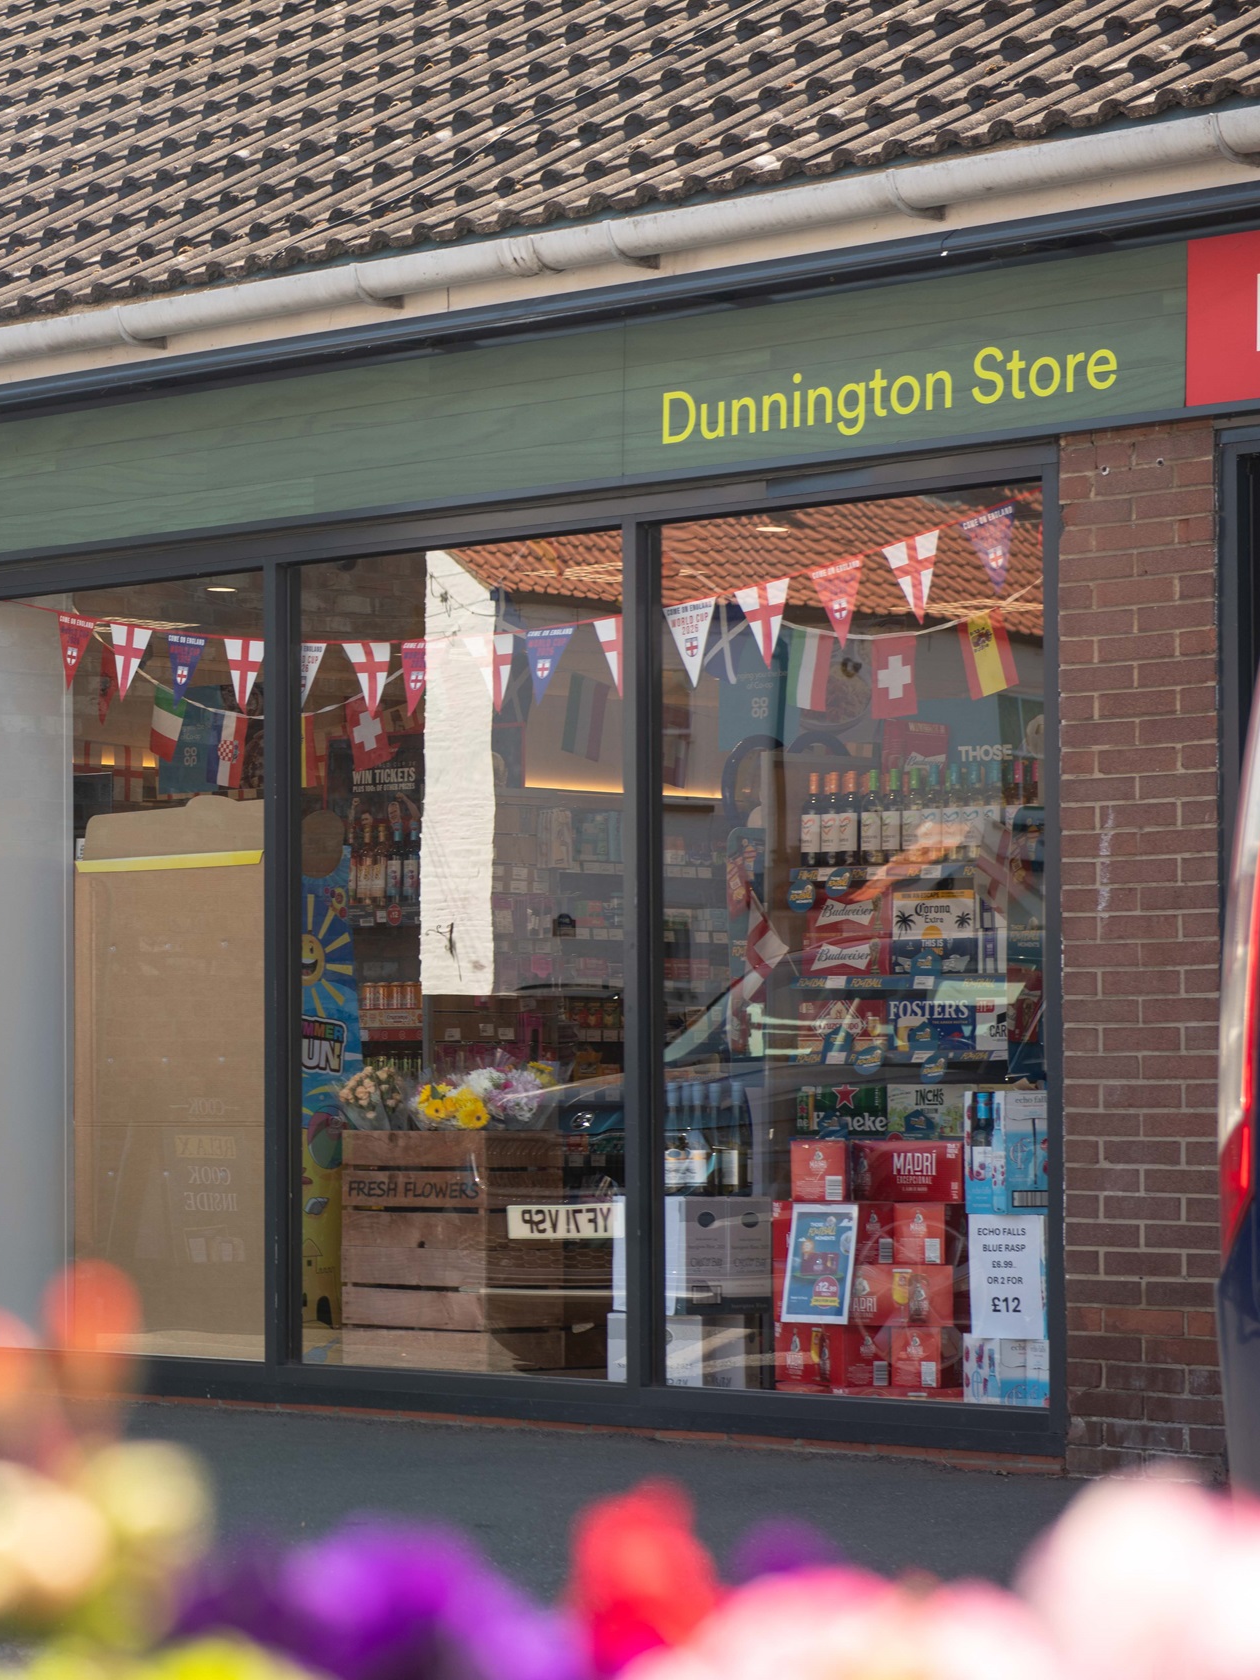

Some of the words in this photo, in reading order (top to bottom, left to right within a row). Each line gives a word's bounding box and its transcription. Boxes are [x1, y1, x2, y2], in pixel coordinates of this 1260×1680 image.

[661, 369, 952, 444] Dunnington
[972, 347, 1118, 405] Store
[667, 608, 680, 616] COME
[690, 601, 712, 612] ENGLAND
[76, 619, 94, 629] ENGLAND
[671, 616, 694, 628] WORLD
[696, 612, 709, 623] CUP
[550, 628, 573, 636] ENGLAND
[682, 624, 699, 635] 2026
[168, 635, 180, 643] COME
[186, 636, 205, 646] ENGLAND
[308, 656, 318, 664] CUP
[958, 744, 1013, 762] THOSE
[353, 770, 372, 785] WIN
[375, 767, 416, 784] TICKETS
[353, 785, 364, 793] PLUS
[376, 784, 383, 792] OF
[821, 904, 874, 918] Budweiser
[915, 903, 950, 917] Corona
[924, 915, 944, 924] Extra
[921, 939, 936, 947] THIS
[937, 939, 944, 947] IS
[817, 948, 871, 962] Budweiser
[890, 1000, 969, 1019] FOSTER'S
[302, 1021, 343, 1041] MMER
[302, 1038, 341, 1071] UN
[915, 1088, 944, 1106] INCH'S
[1015, 1096, 1032, 1104] echo
[893, 1150, 937, 1176] MADRÍ
[896, 1176, 933, 1185] EXCEPCIONAL
[349, 1180, 397, 1198] FRESH
[405, 1181, 479, 1199] FLOWERS
[808, 1227, 836, 1236] FOOTBALL
[977, 1228, 1000, 1236] ECHO
[1002, 1228, 1026, 1236] FALLS
[982, 1244, 1002, 1253] BLUE
[1004, 1244, 1026, 1253] RASP
[987, 1276, 1000, 1285] OR
[1001, 1276, 1006, 1285] 2
[1007, 1276, 1024, 1285] FOR
[991, 1297, 1021, 1314] £12
